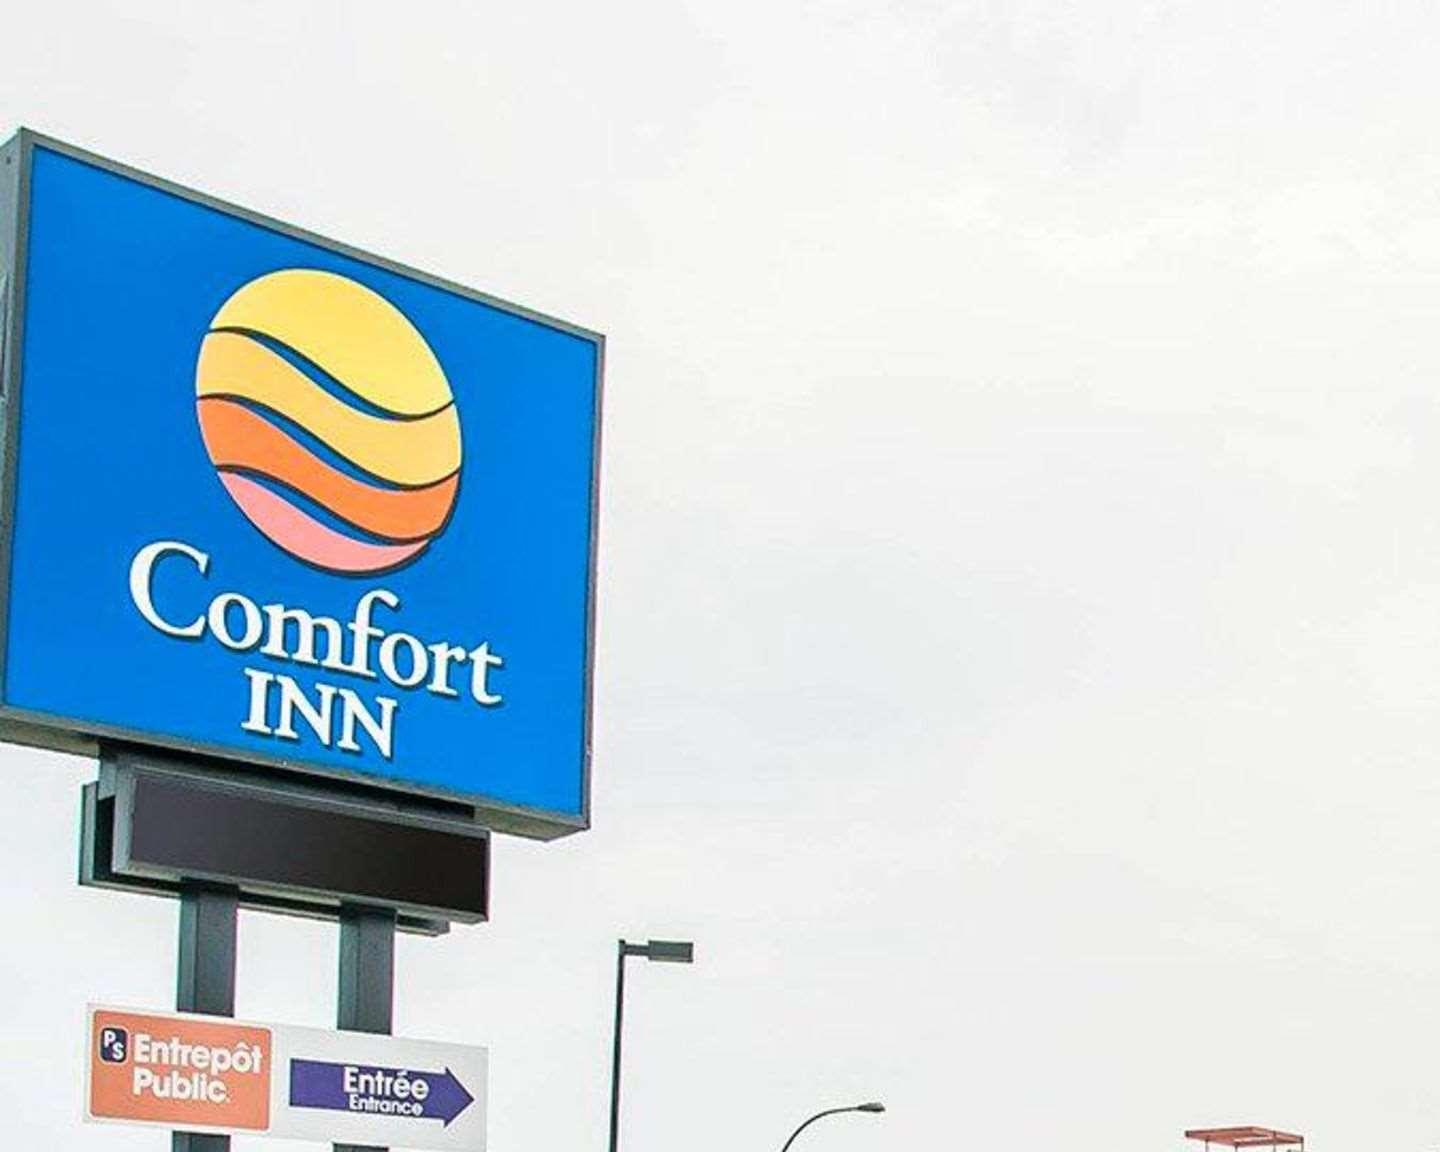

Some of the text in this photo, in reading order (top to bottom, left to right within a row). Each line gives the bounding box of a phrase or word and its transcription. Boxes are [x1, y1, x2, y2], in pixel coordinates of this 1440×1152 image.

[128, 540, 503, 707] Comfort
[241, 667, 399, 758] INN
[133, 1034, 264, 1075] Entrepôt
[132, 1067, 229, 1104] Public
[342, 1065, 430, 1101] Entrée
[349, 1093, 424, 1118] Entrance
